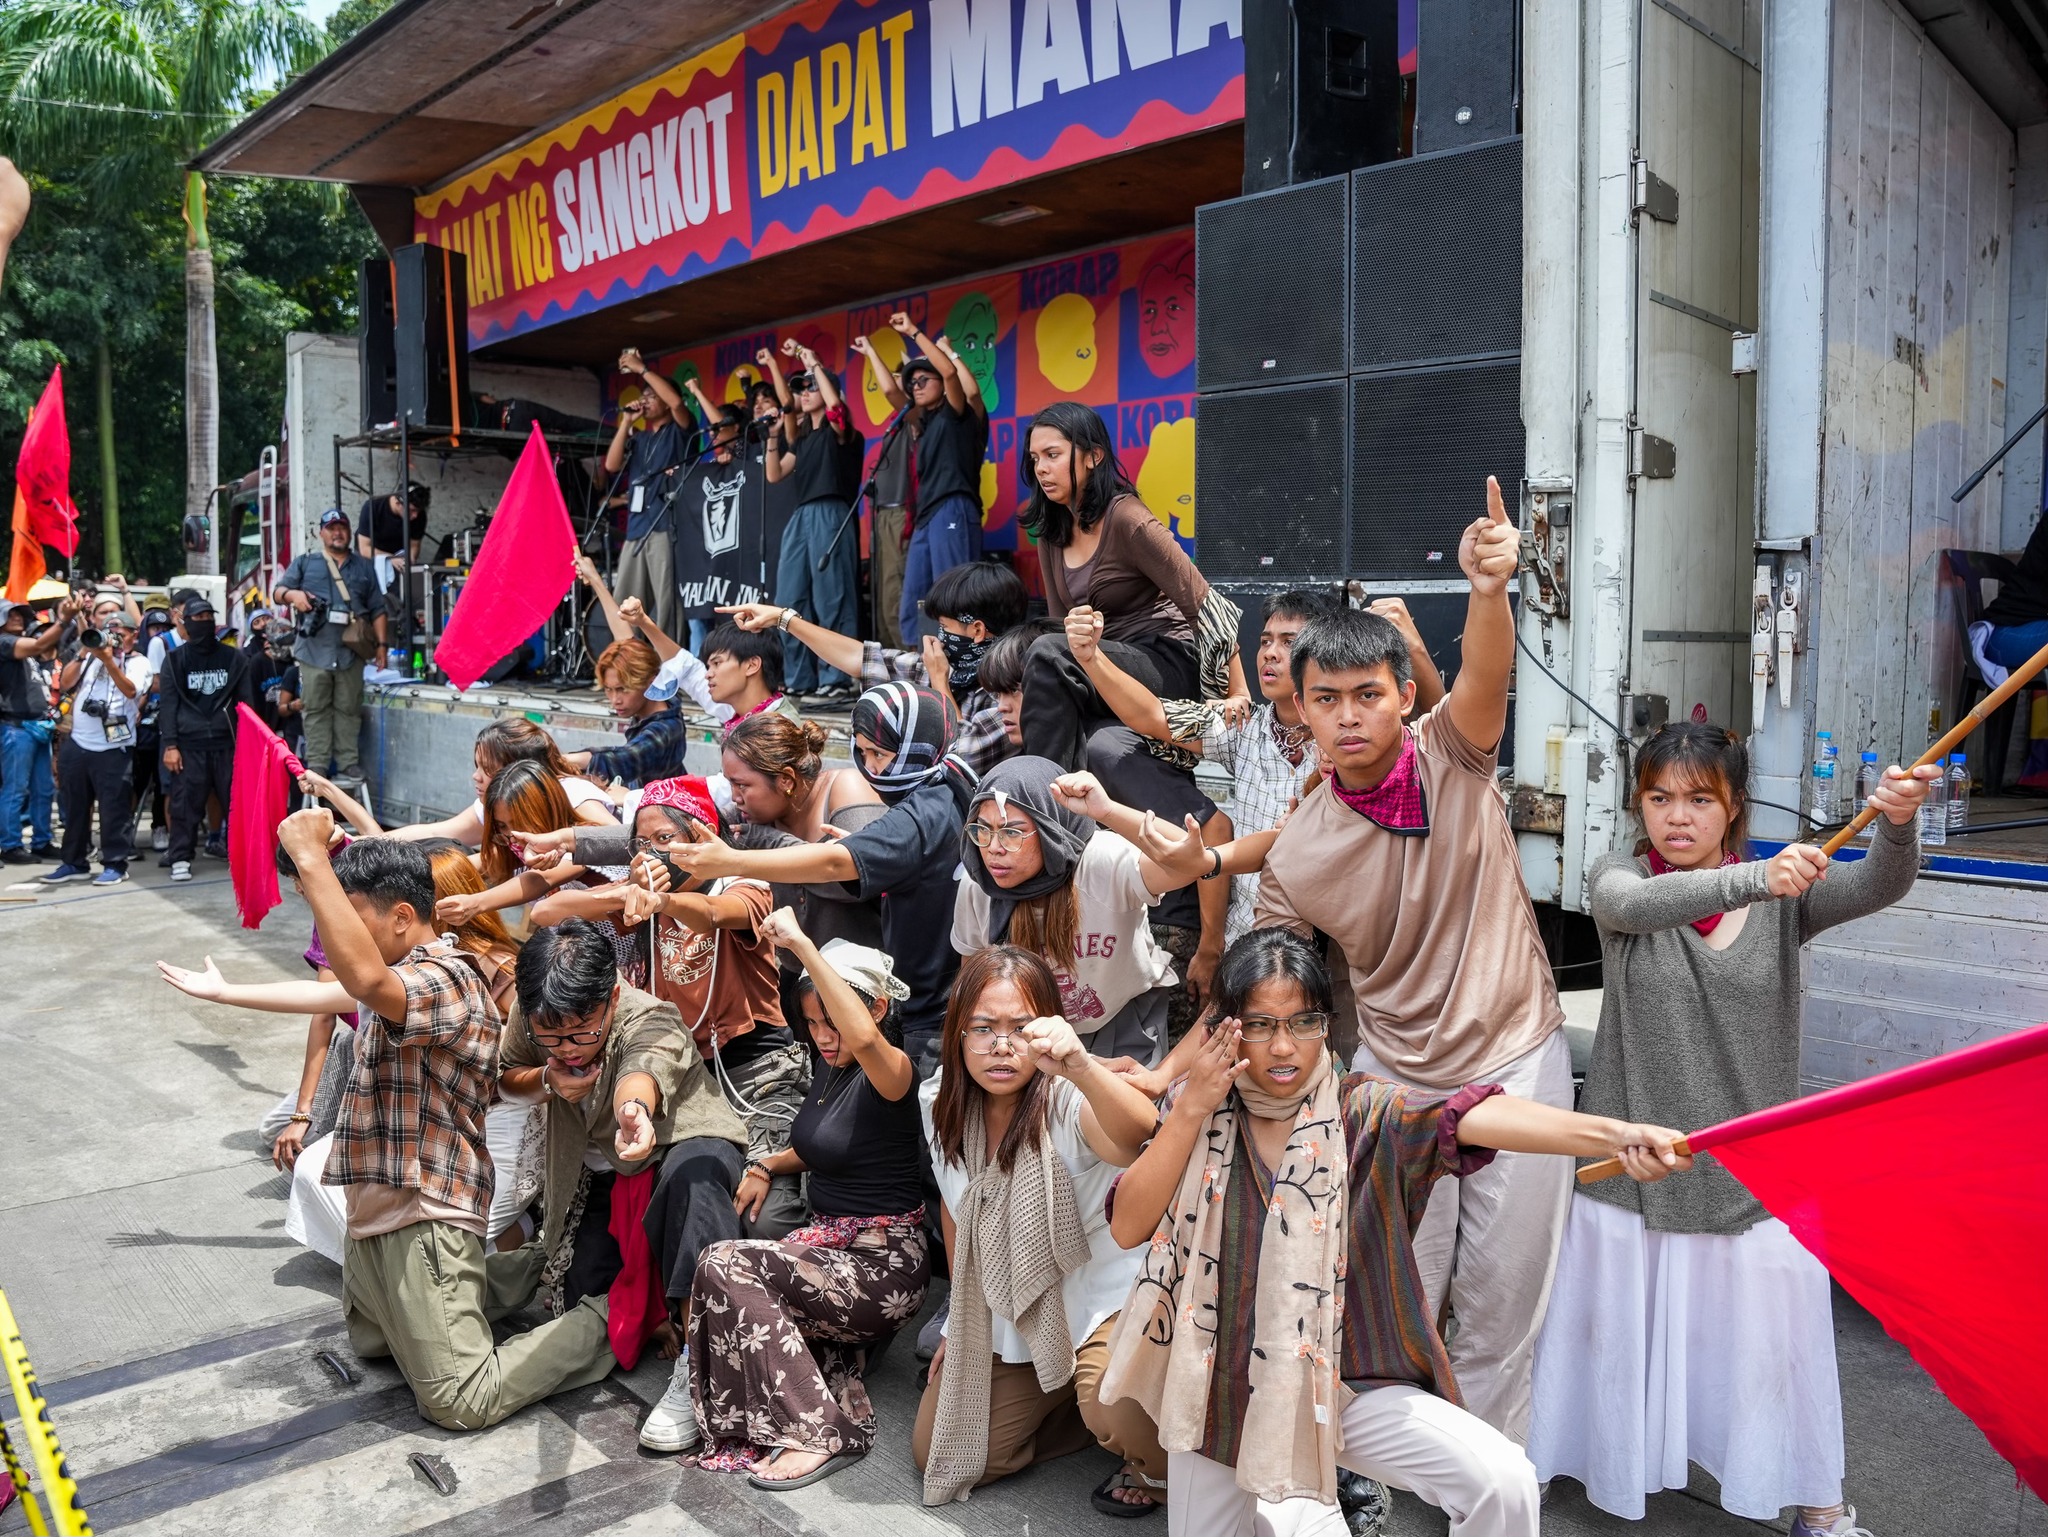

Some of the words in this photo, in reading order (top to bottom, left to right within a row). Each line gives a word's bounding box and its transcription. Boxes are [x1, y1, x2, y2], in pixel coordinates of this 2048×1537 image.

[415, 203, 504, 308] HAT
[508, 182, 554, 290] NG
[553, 91, 733, 273] SANGKOT
[757, 10, 914, 198] DAPAT
[929, 0, 1243, 138] MA
[1021, 252, 1119, 312] KORAP
